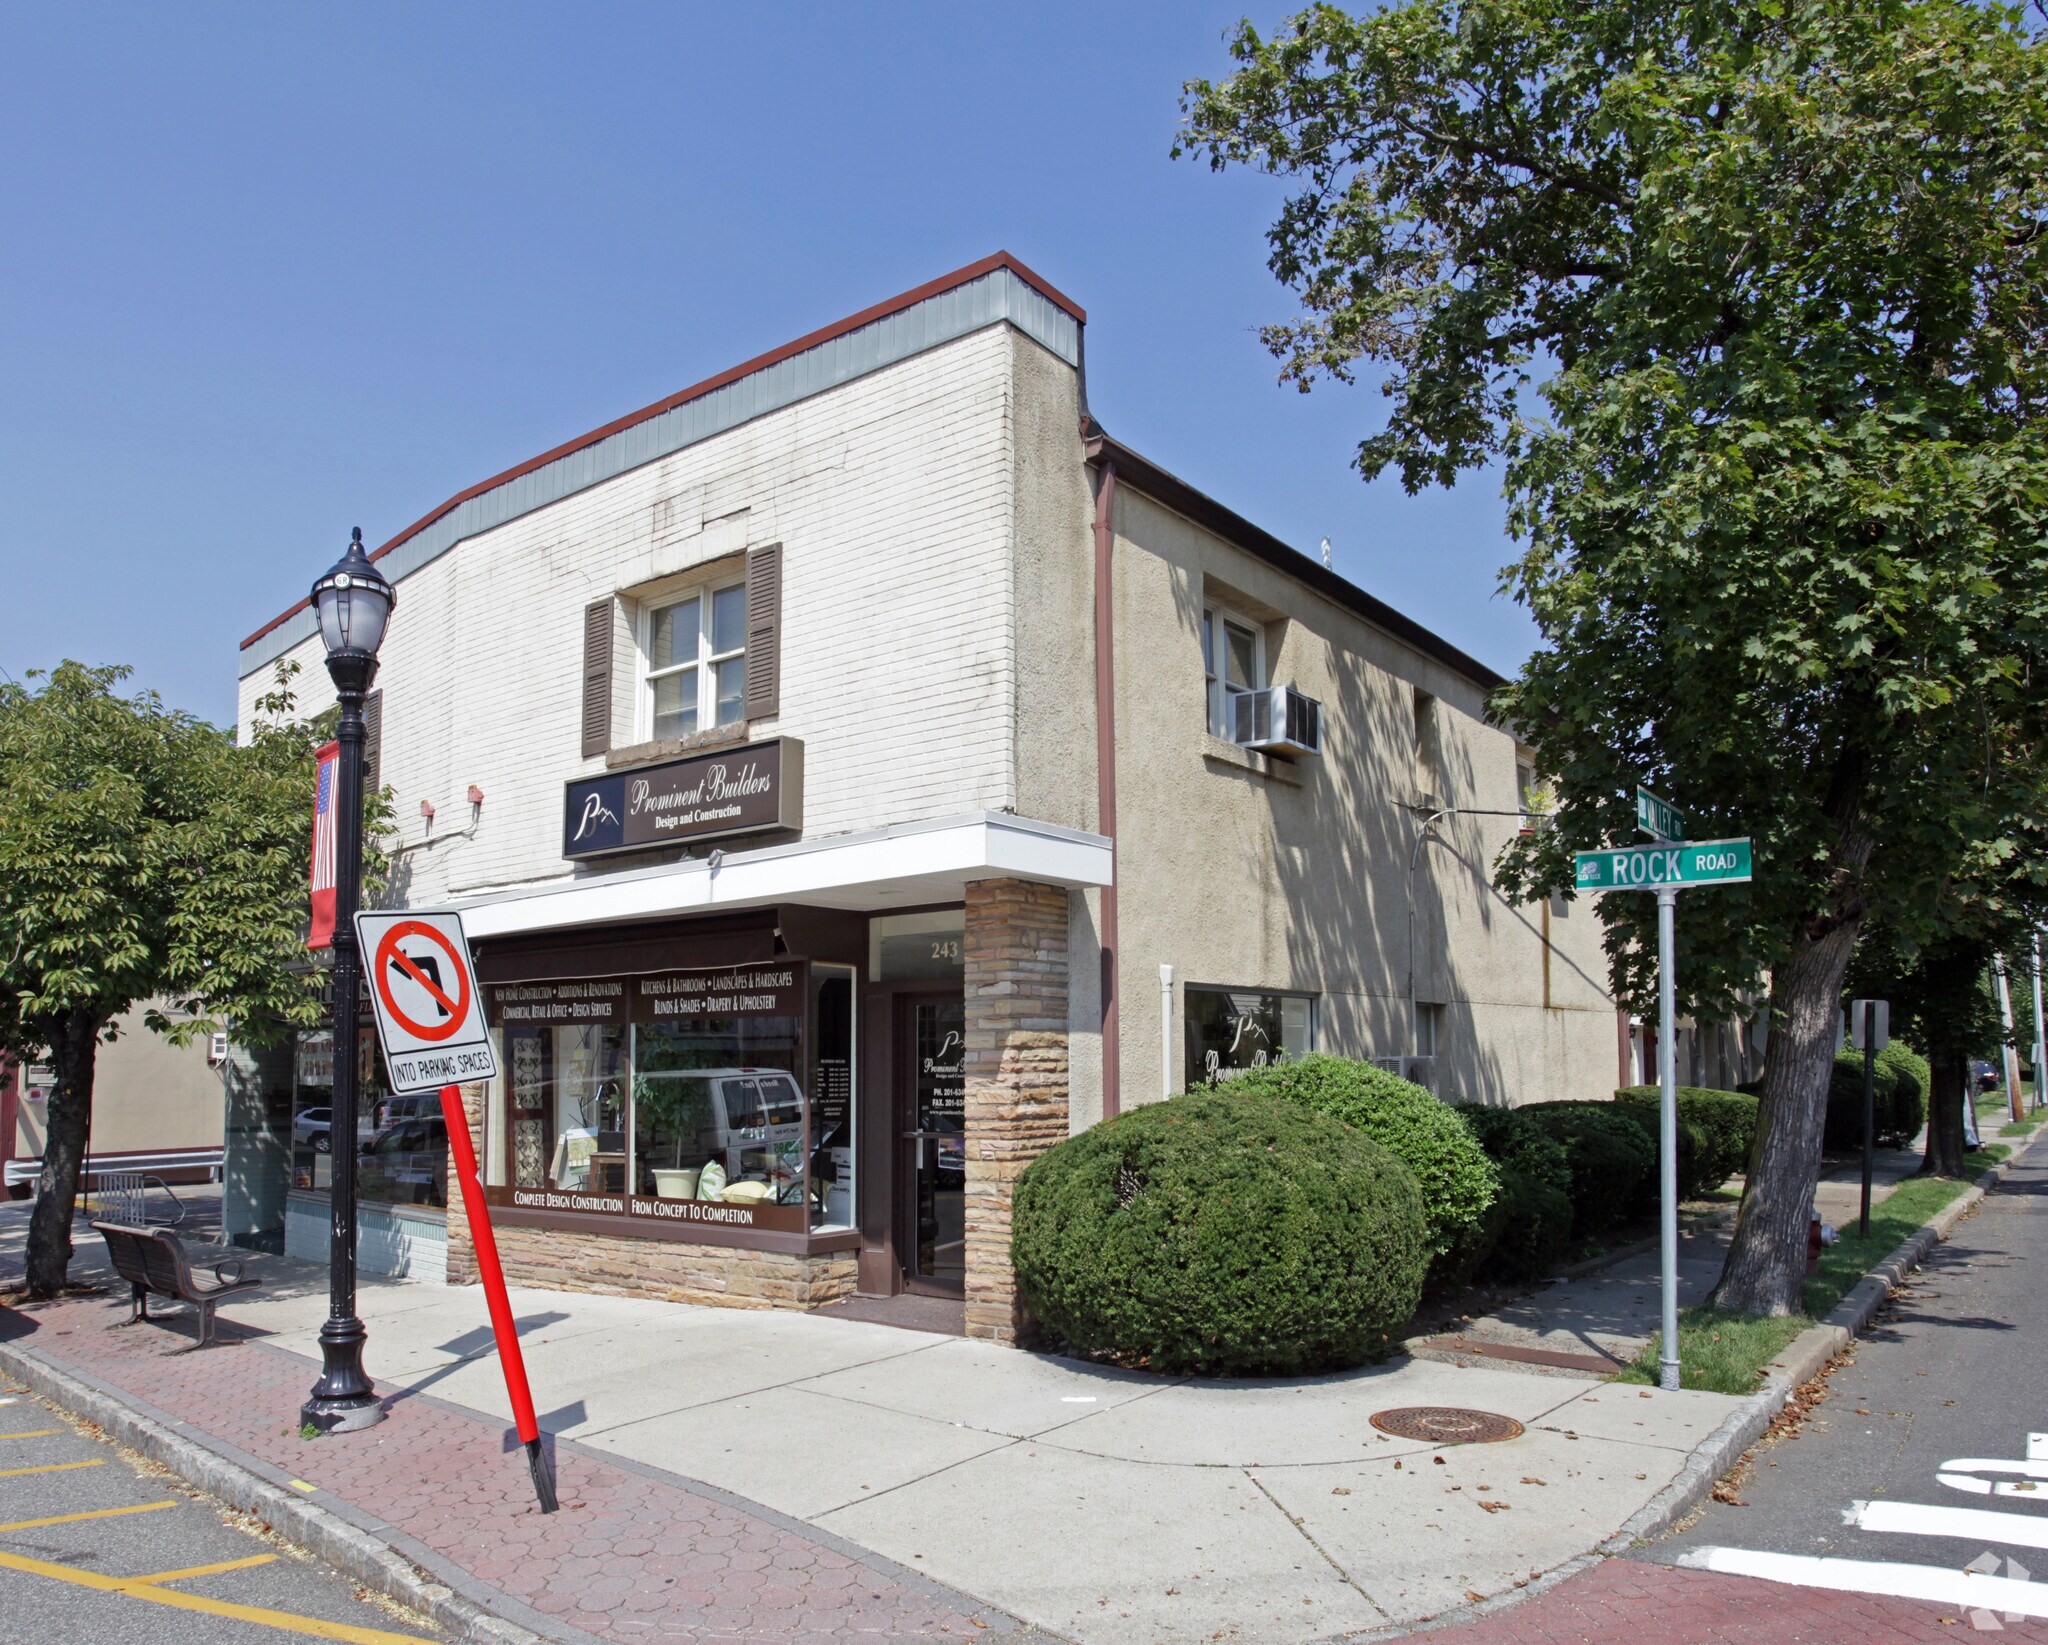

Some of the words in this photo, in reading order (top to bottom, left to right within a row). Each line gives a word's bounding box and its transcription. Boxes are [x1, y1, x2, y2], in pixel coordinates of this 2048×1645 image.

[336, 576, 348, 584] GR
[630, 780, 705, 815] Prominent
[706, 762, 770, 802] Builders
[656, 814, 678, 829] Design
[680, 811, 693, 825] and
[694, 804, 741, 822] Construction
[1646, 798, 1672, 838] VALLEY
[1612, 850, 1682, 884] ROCK
[1696, 852, 1737, 871] ROAD
[932, 941, 958, 959] 243
[520, 986, 552, 1000] CONSTRUCTION
[557, 985, 582, 998] ADDITIONS
[584, 984, 588, 997] &
[588, 982, 622, 996] RENOVATIONS
[641, 980, 666, 994] KITCHENS
[666, 978, 671, 992] &
[672, 978, 706, 992] BATHROOMS
[712, 974, 747, 990] LANDSCAPES
[748, 973, 754, 988] &
[755, 972, 792, 988] HARDSCAPES
[532, 1004, 546, 1019] RETAIL
[547, 1004, 551, 1018] &
[552, 1004, 567, 1017] OFFICE
[573, 1002, 590, 1017] DESIGN
[591, 1002, 612, 1016] SERVICES
[654, 1000, 672, 1014] BLINDS
[674, 999, 678, 1013] &
[680, 998, 700, 1014] SHADES
[707, 996, 732, 1012] DRAPERY
[733, 995, 738, 1010] &
[740, 995, 776, 1010] UPHOLSTERY
[394, 1062, 416, 1083] INTO
[418, 1056, 456, 1080] PARKING
[458, 1052, 490, 1073] SPACES
[514, 1191, 545, 1206] COMPLETE
[546, 1193, 570, 1208] DESIGN
[572, 1195, 623, 1212] CONSTRUCTION
[631, 1199, 652, 1215] FROM
[654, 1201, 687, 1218] CONCEPT
[689, 1204, 700, 1219] TO
[702, 1205, 752, 1224] COMPLETION
